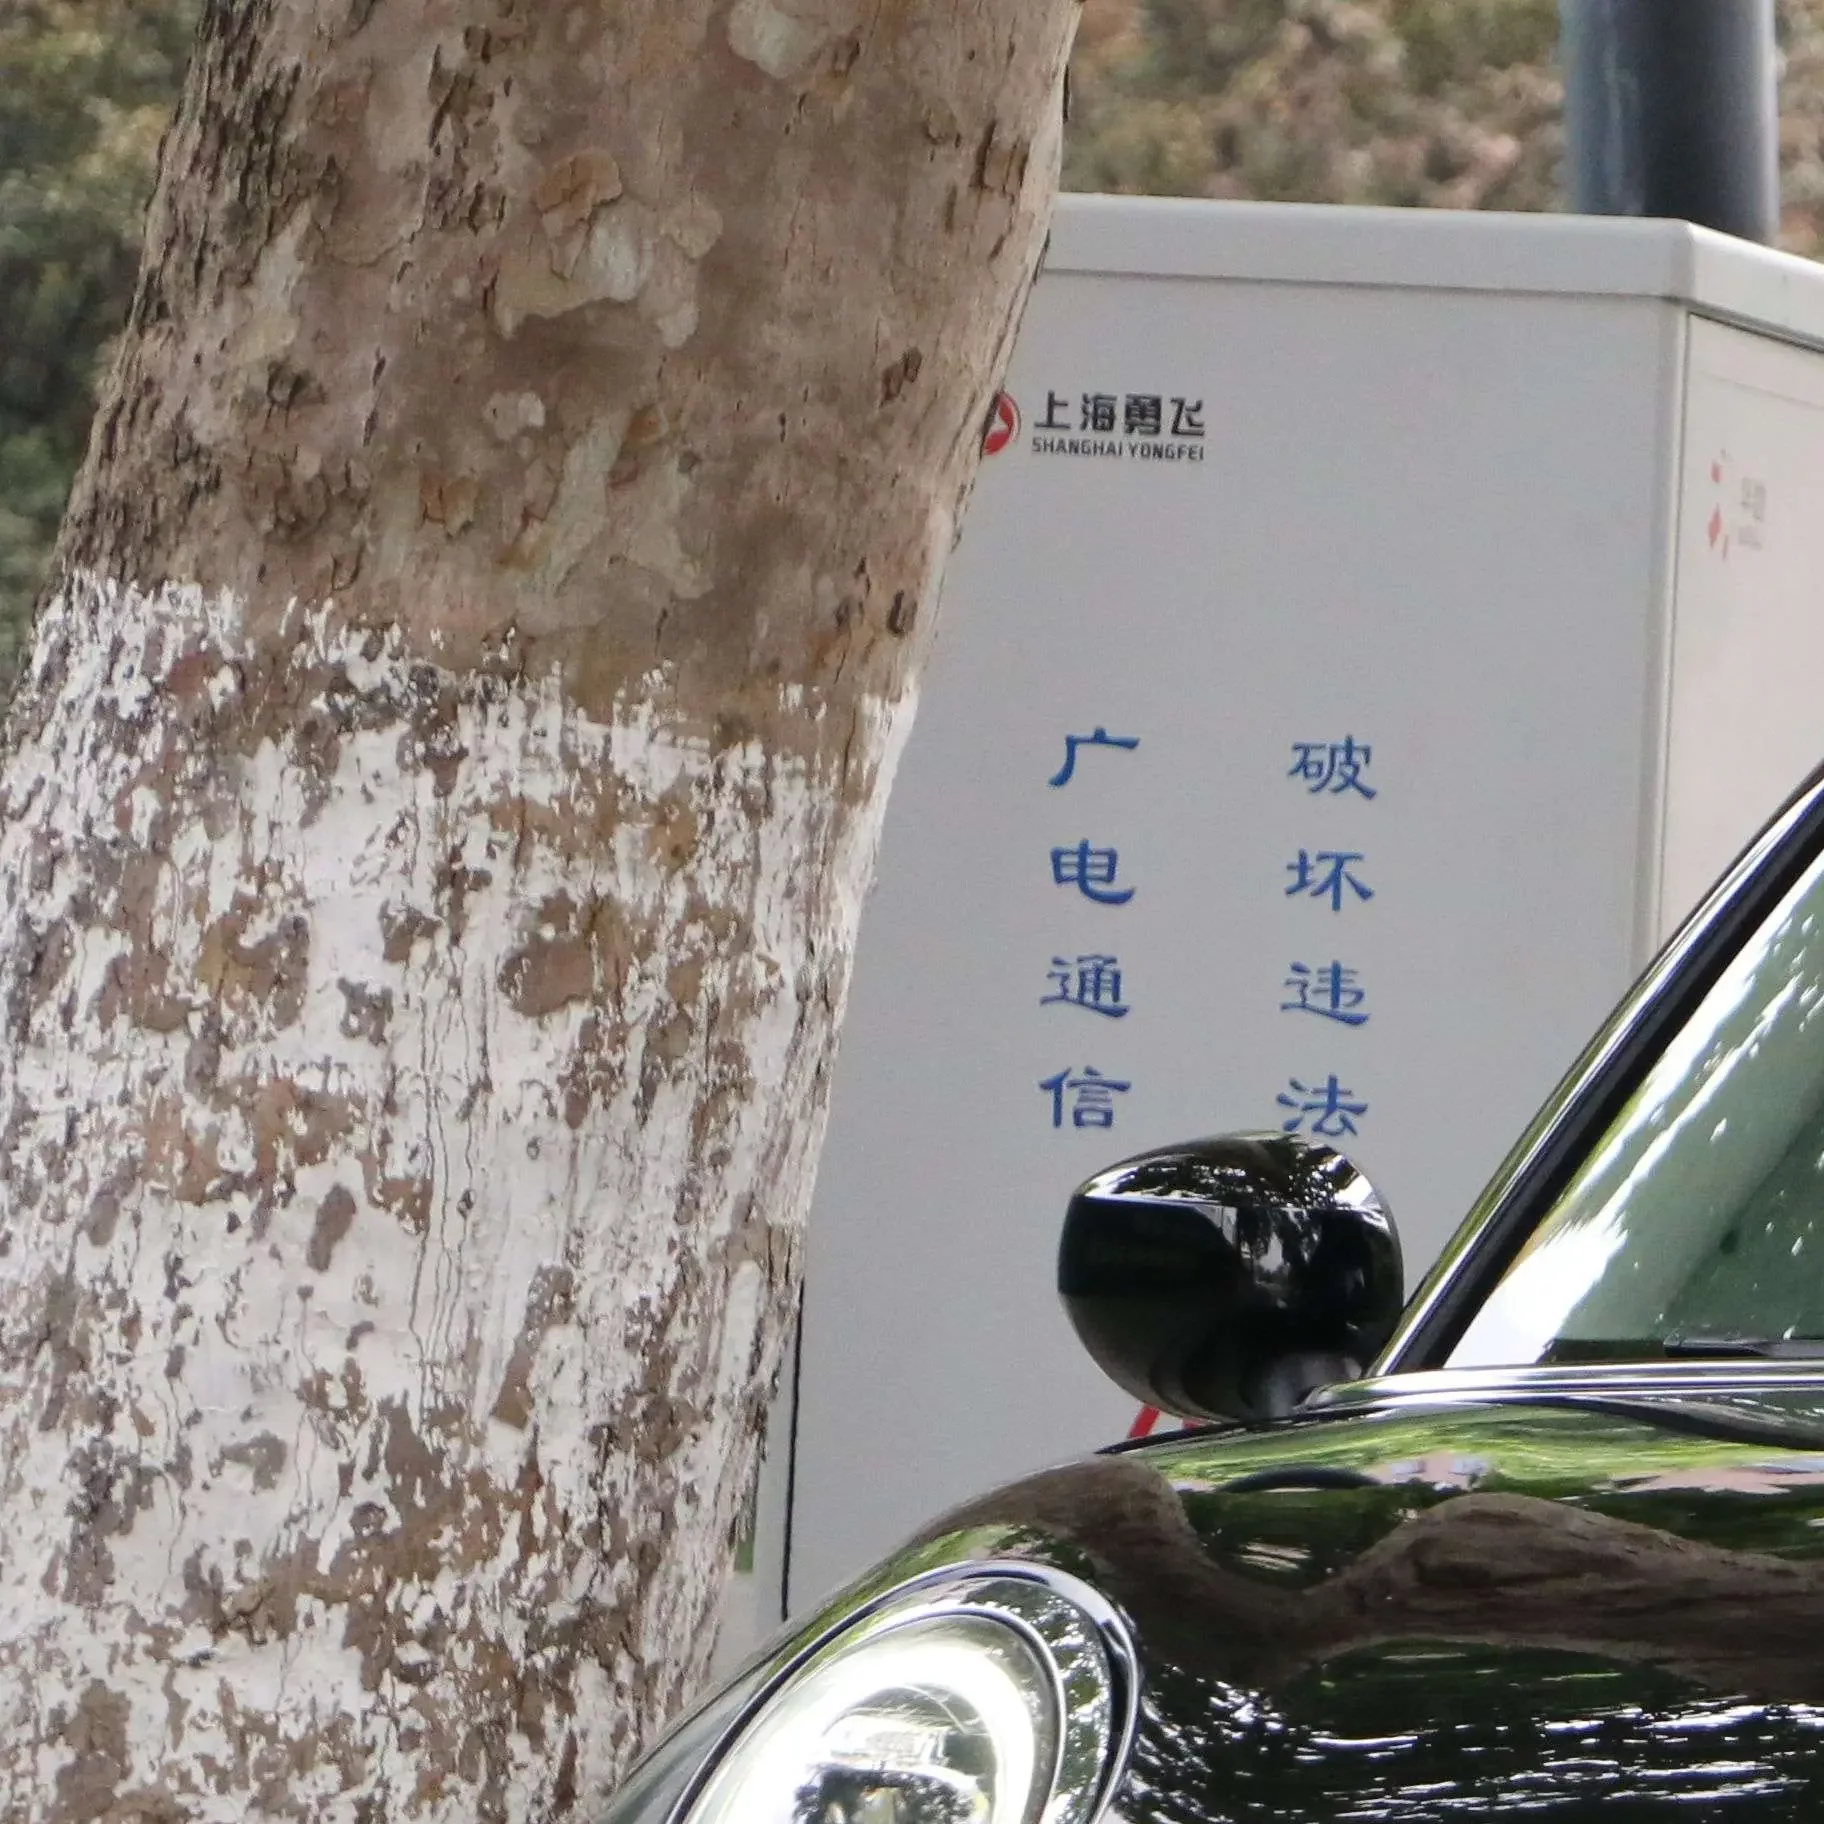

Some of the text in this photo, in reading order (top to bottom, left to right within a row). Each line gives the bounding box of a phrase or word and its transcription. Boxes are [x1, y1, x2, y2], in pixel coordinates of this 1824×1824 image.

[1031, 437, 1204, 462] SHANGHAI YONGFEI
[1034, 389, 1205, 436] 上海勇飞
[1039, 726, 1141, 1129] 广电通信
[1276, 734, 1378, 1136] 破坏违法
